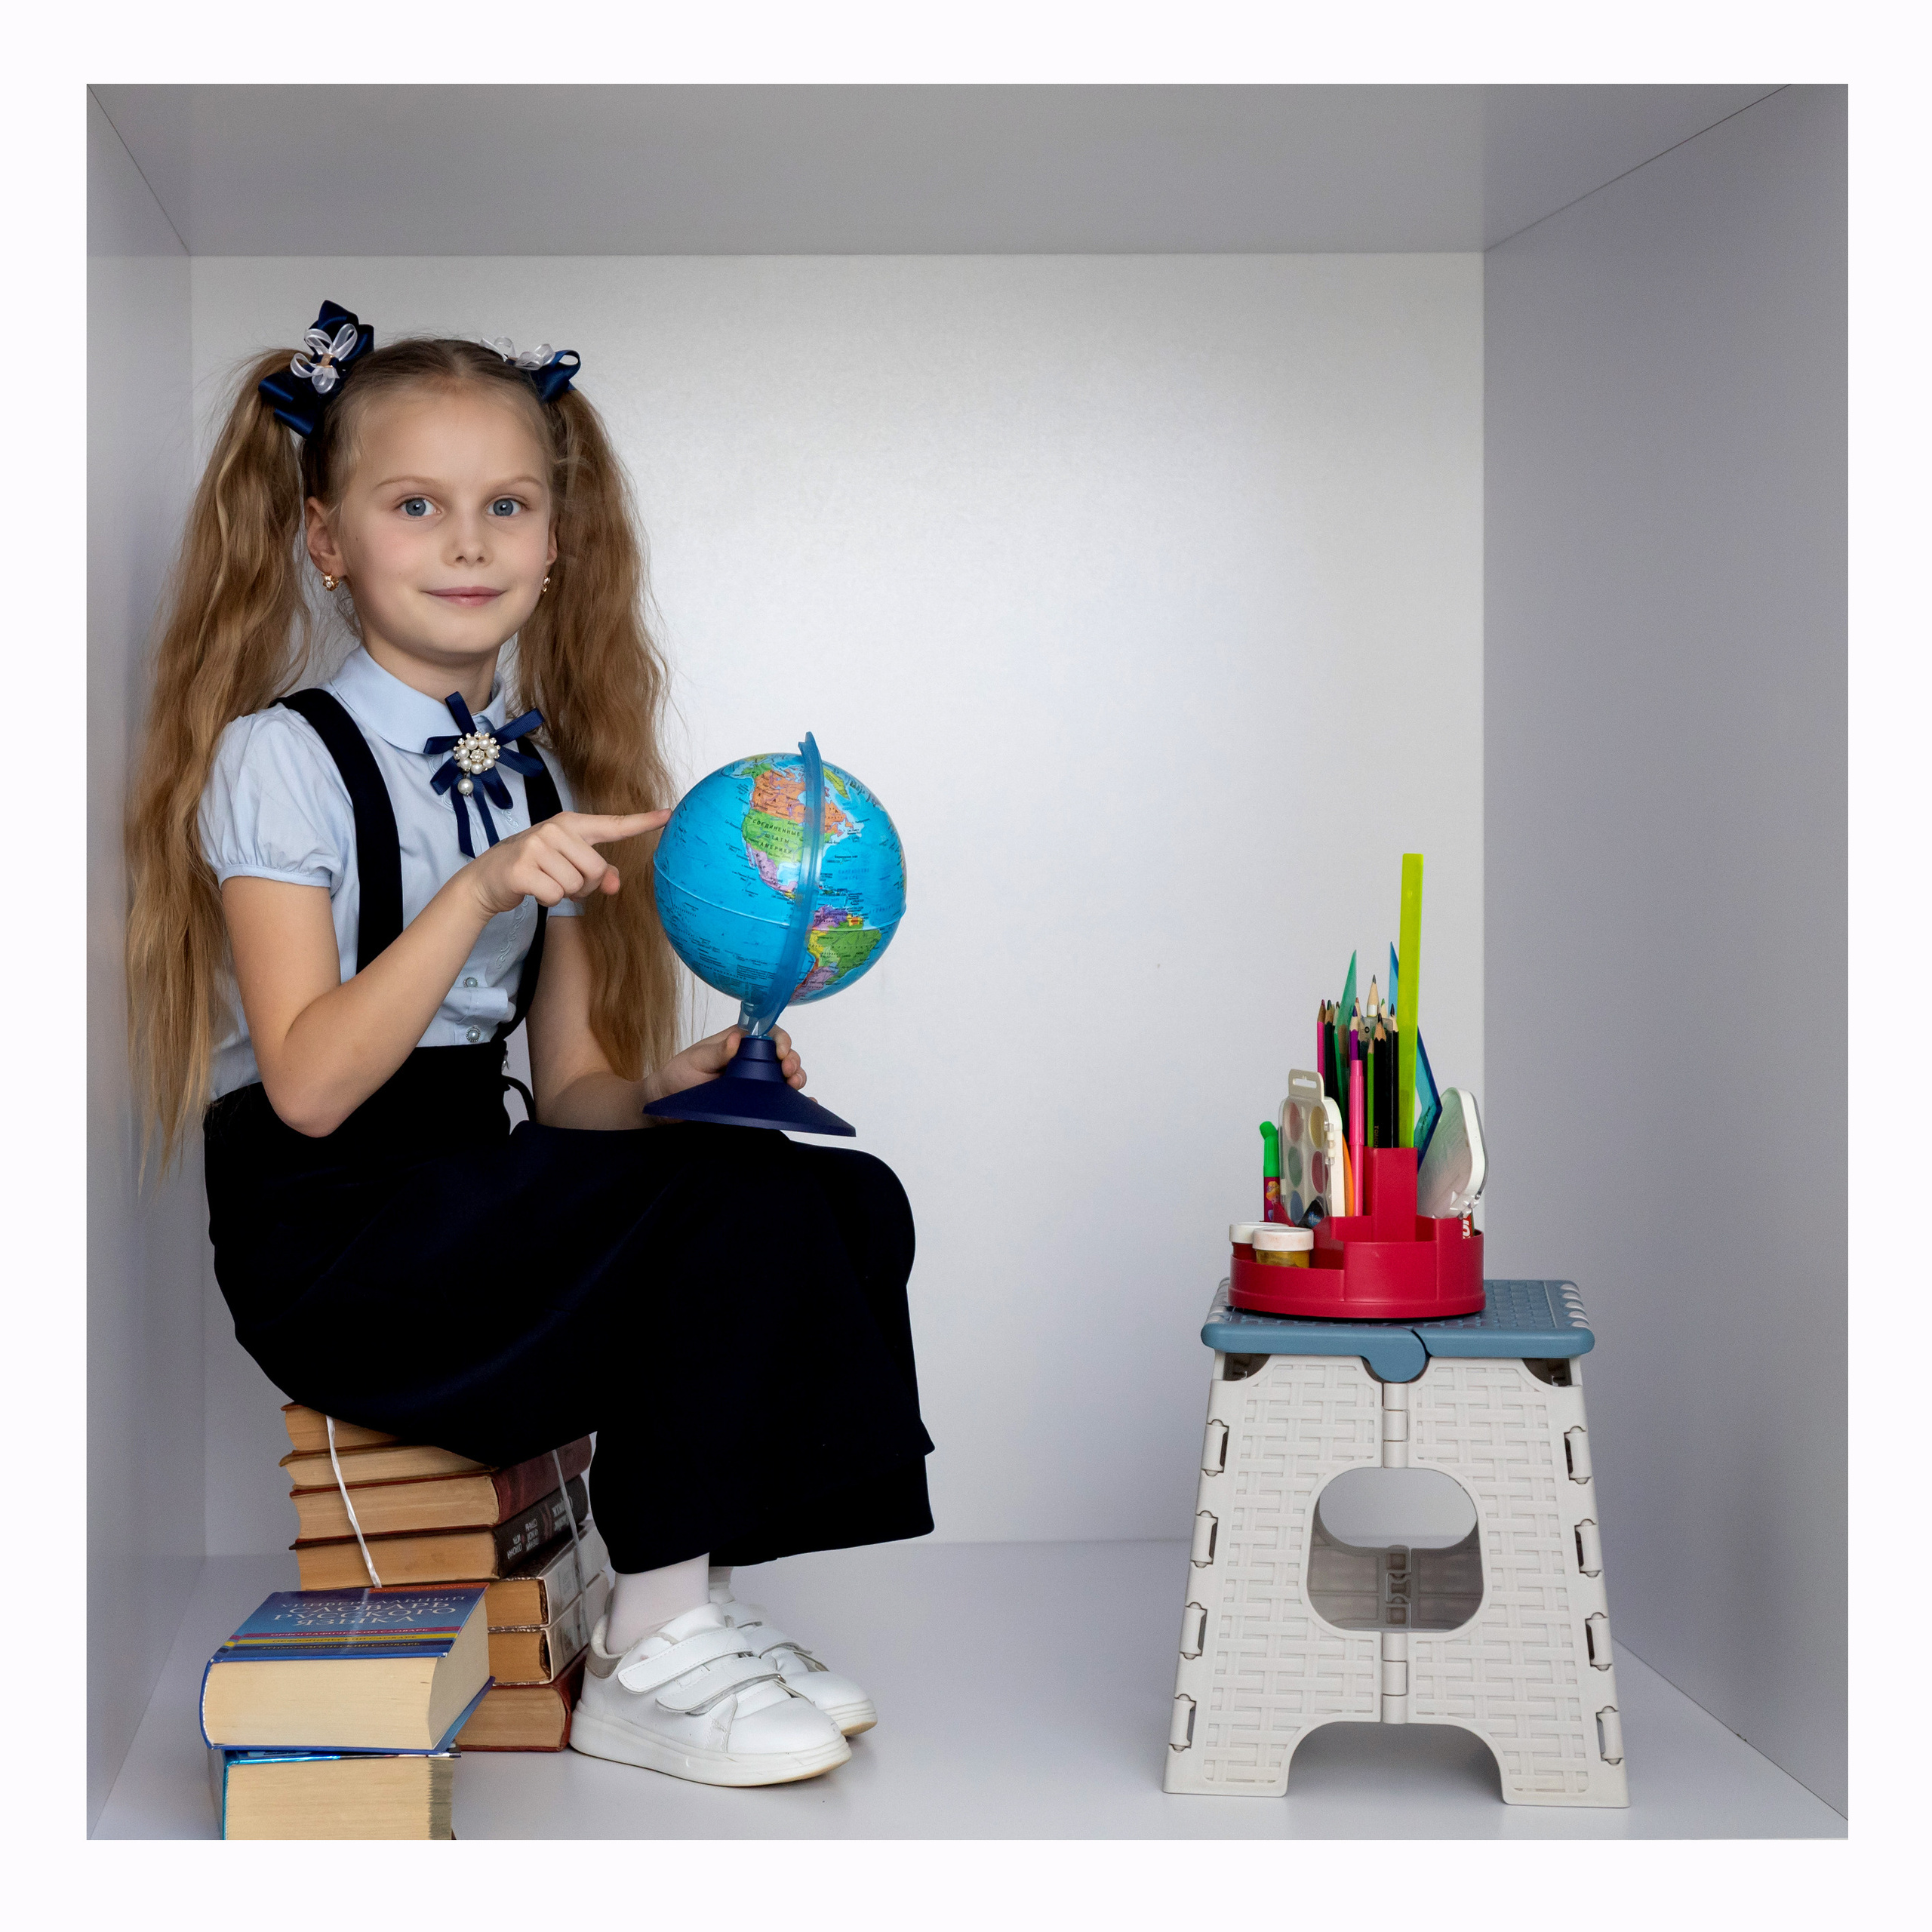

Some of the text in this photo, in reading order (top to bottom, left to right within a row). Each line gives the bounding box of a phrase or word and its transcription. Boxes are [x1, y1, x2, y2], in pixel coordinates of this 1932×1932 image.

[752, 819, 800, 837] СОЕДИНЕННЫЕ
[764, 833, 789, 844] ШТАТЫ
[760, 842, 792, 854] АМЕРИКИ
[281, 1596, 466, 1607] УНИВЕРСАЛЬНЫЙ
[289, 1601, 450, 1614] СЛОВАРЬ
[274, 1607, 457, 1620] РУССКОГО
[293, 1616, 415, 1626] ЯЗЫКА
